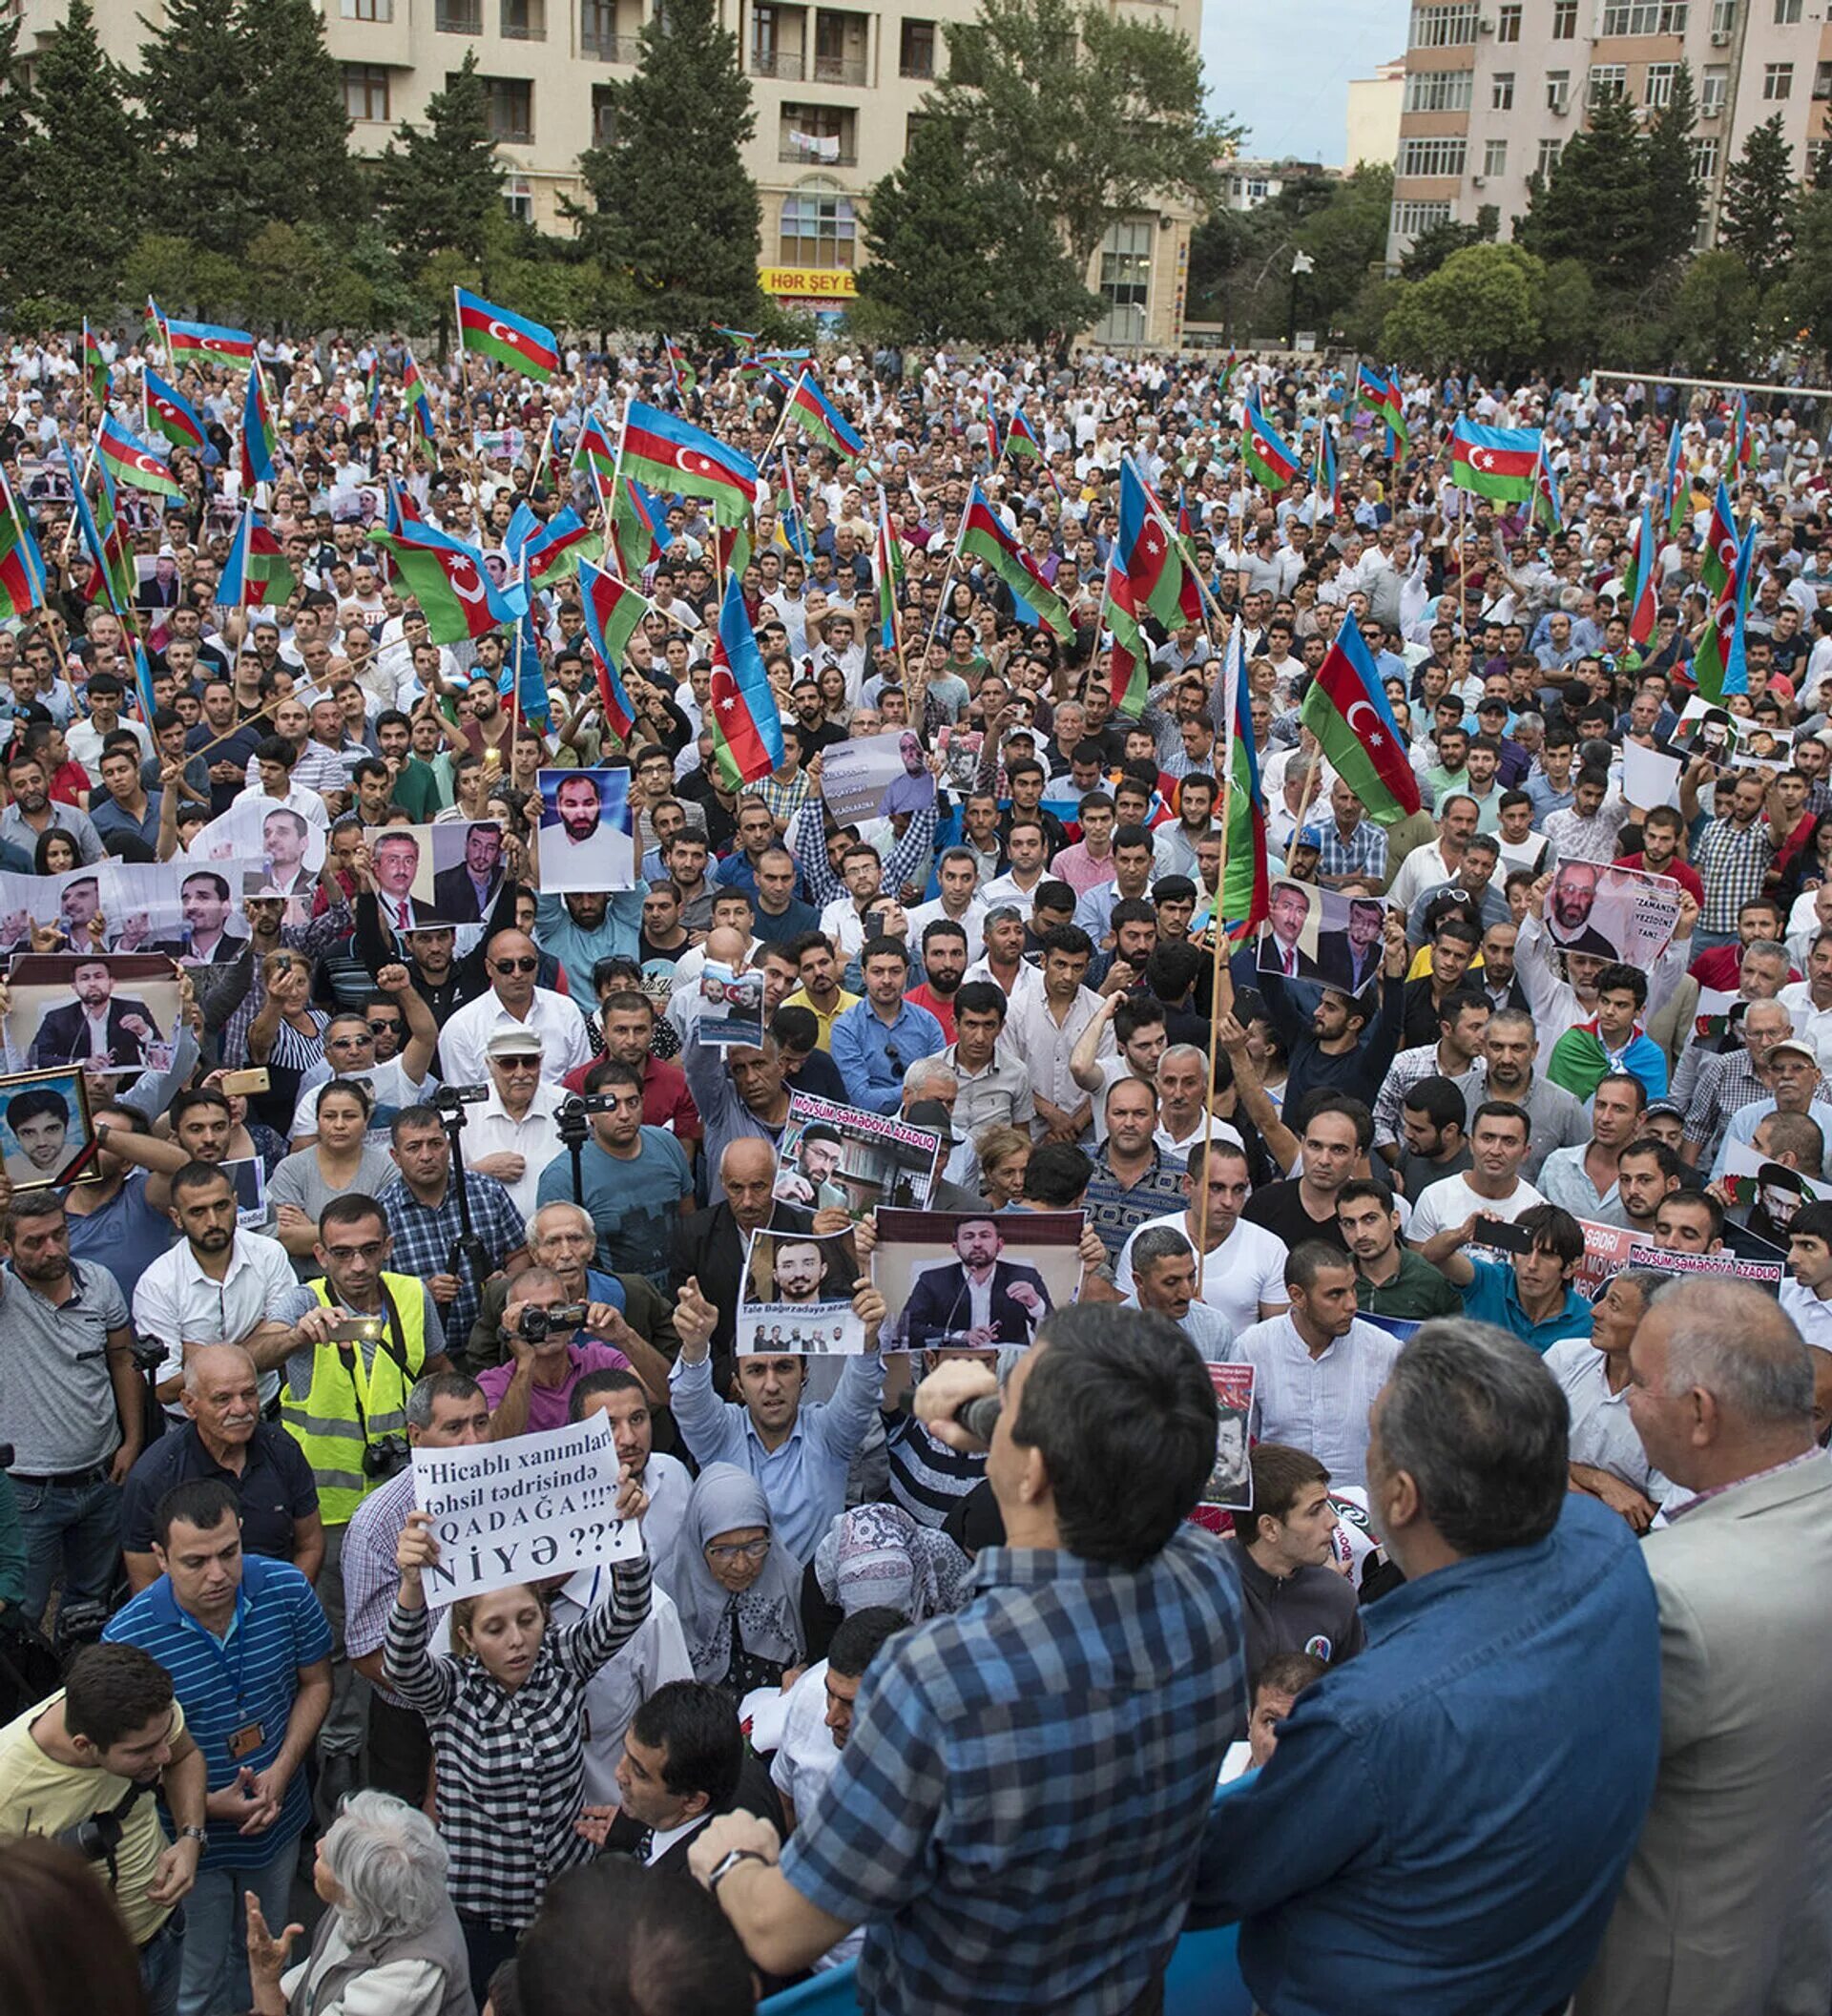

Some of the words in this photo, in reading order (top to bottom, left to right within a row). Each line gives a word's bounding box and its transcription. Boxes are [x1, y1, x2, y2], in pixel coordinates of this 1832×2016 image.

[771, 274, 804, 289] HƏR
[810, 275, 840, 292] ŞEY
[836, 1108, 891, 1135] SƏMƏDOVA
[893, 1127, 937, 1153] AZADLIQ
[1736, 1264, 1780, 1281] AZADLIQ
[425, 1488, 484, 1516] təhsil
[491, 1465, 597, 1502] tədrisində
